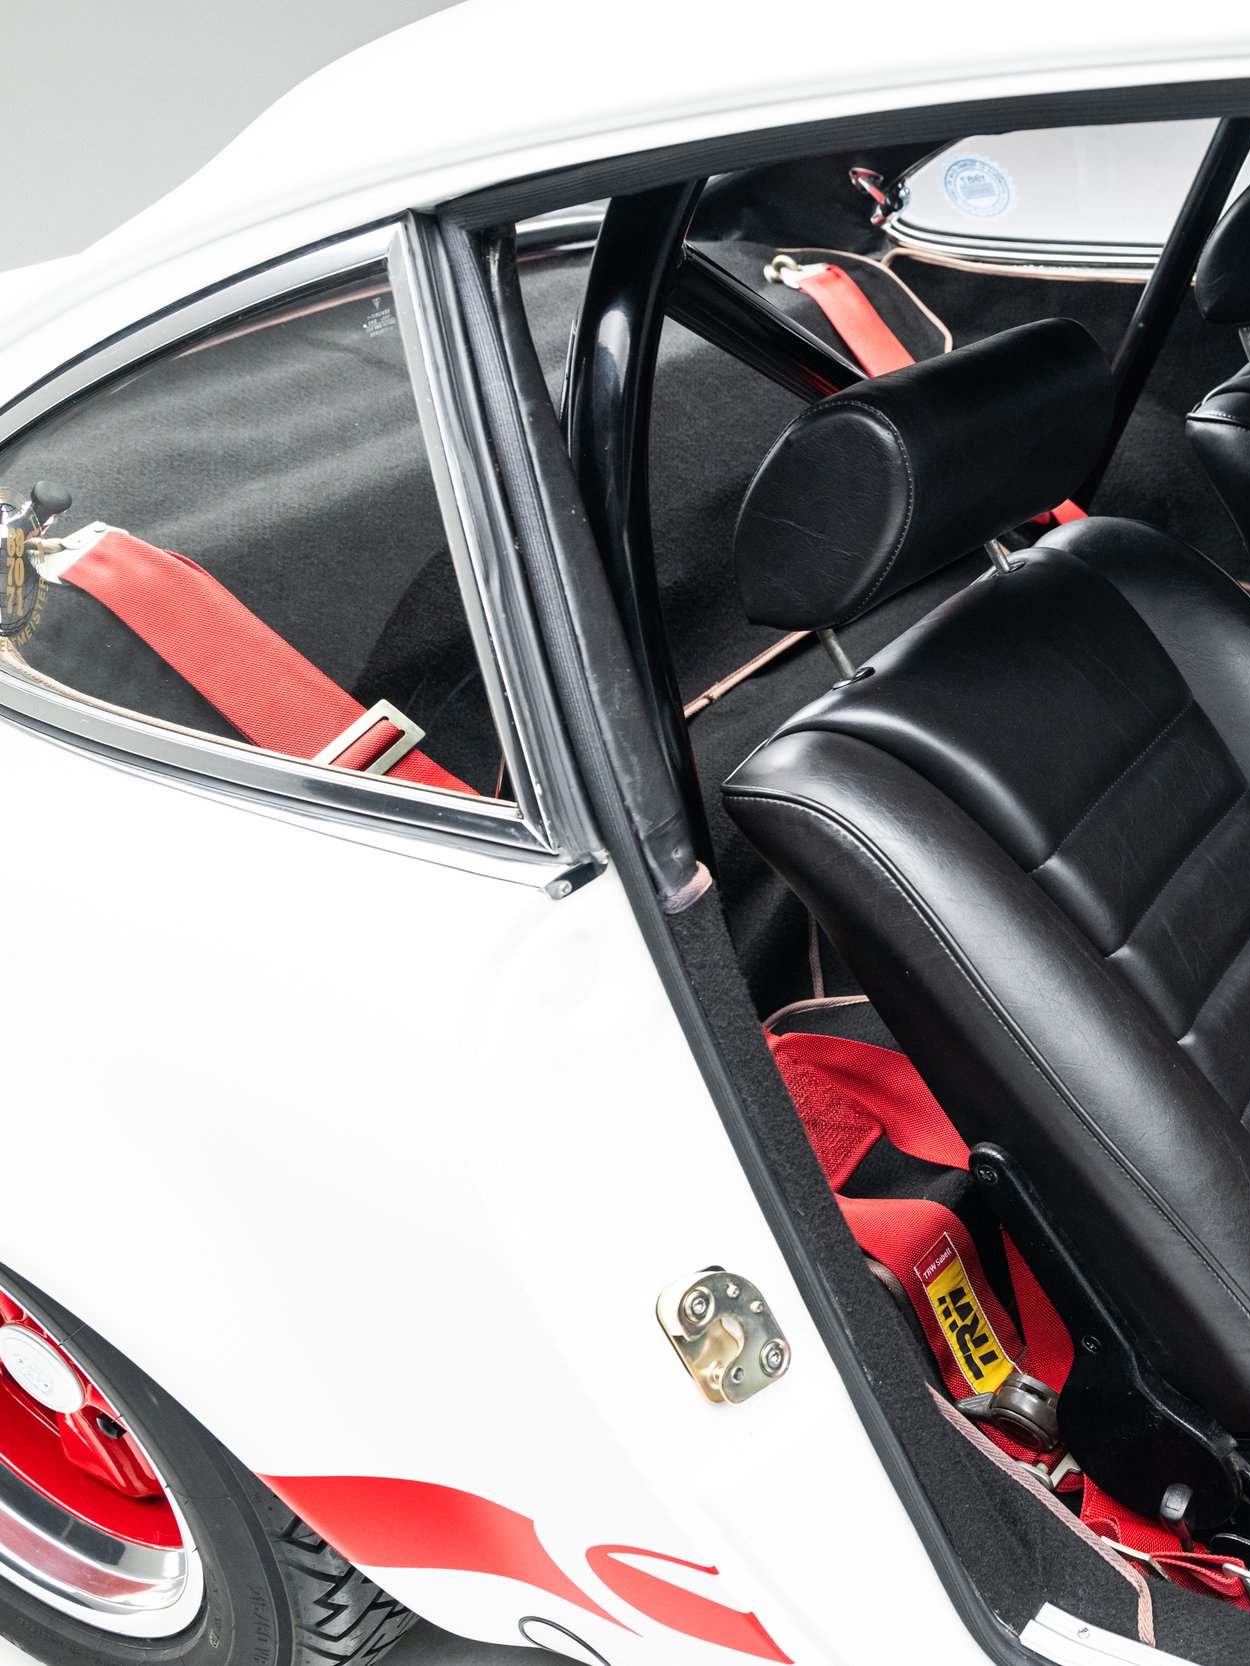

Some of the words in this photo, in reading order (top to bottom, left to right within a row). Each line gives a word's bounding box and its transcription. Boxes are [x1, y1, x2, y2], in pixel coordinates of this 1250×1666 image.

[6, 557, 25, 588] 70
[0, 575, 48, 653] ELTMEISTER
[6, 586, 24, 617] 71
[922, 1262, 937, 1280] TRW
[935, 1247, 952, 1267] Sabelt
[937, 1286, 999, 1381] TRW
